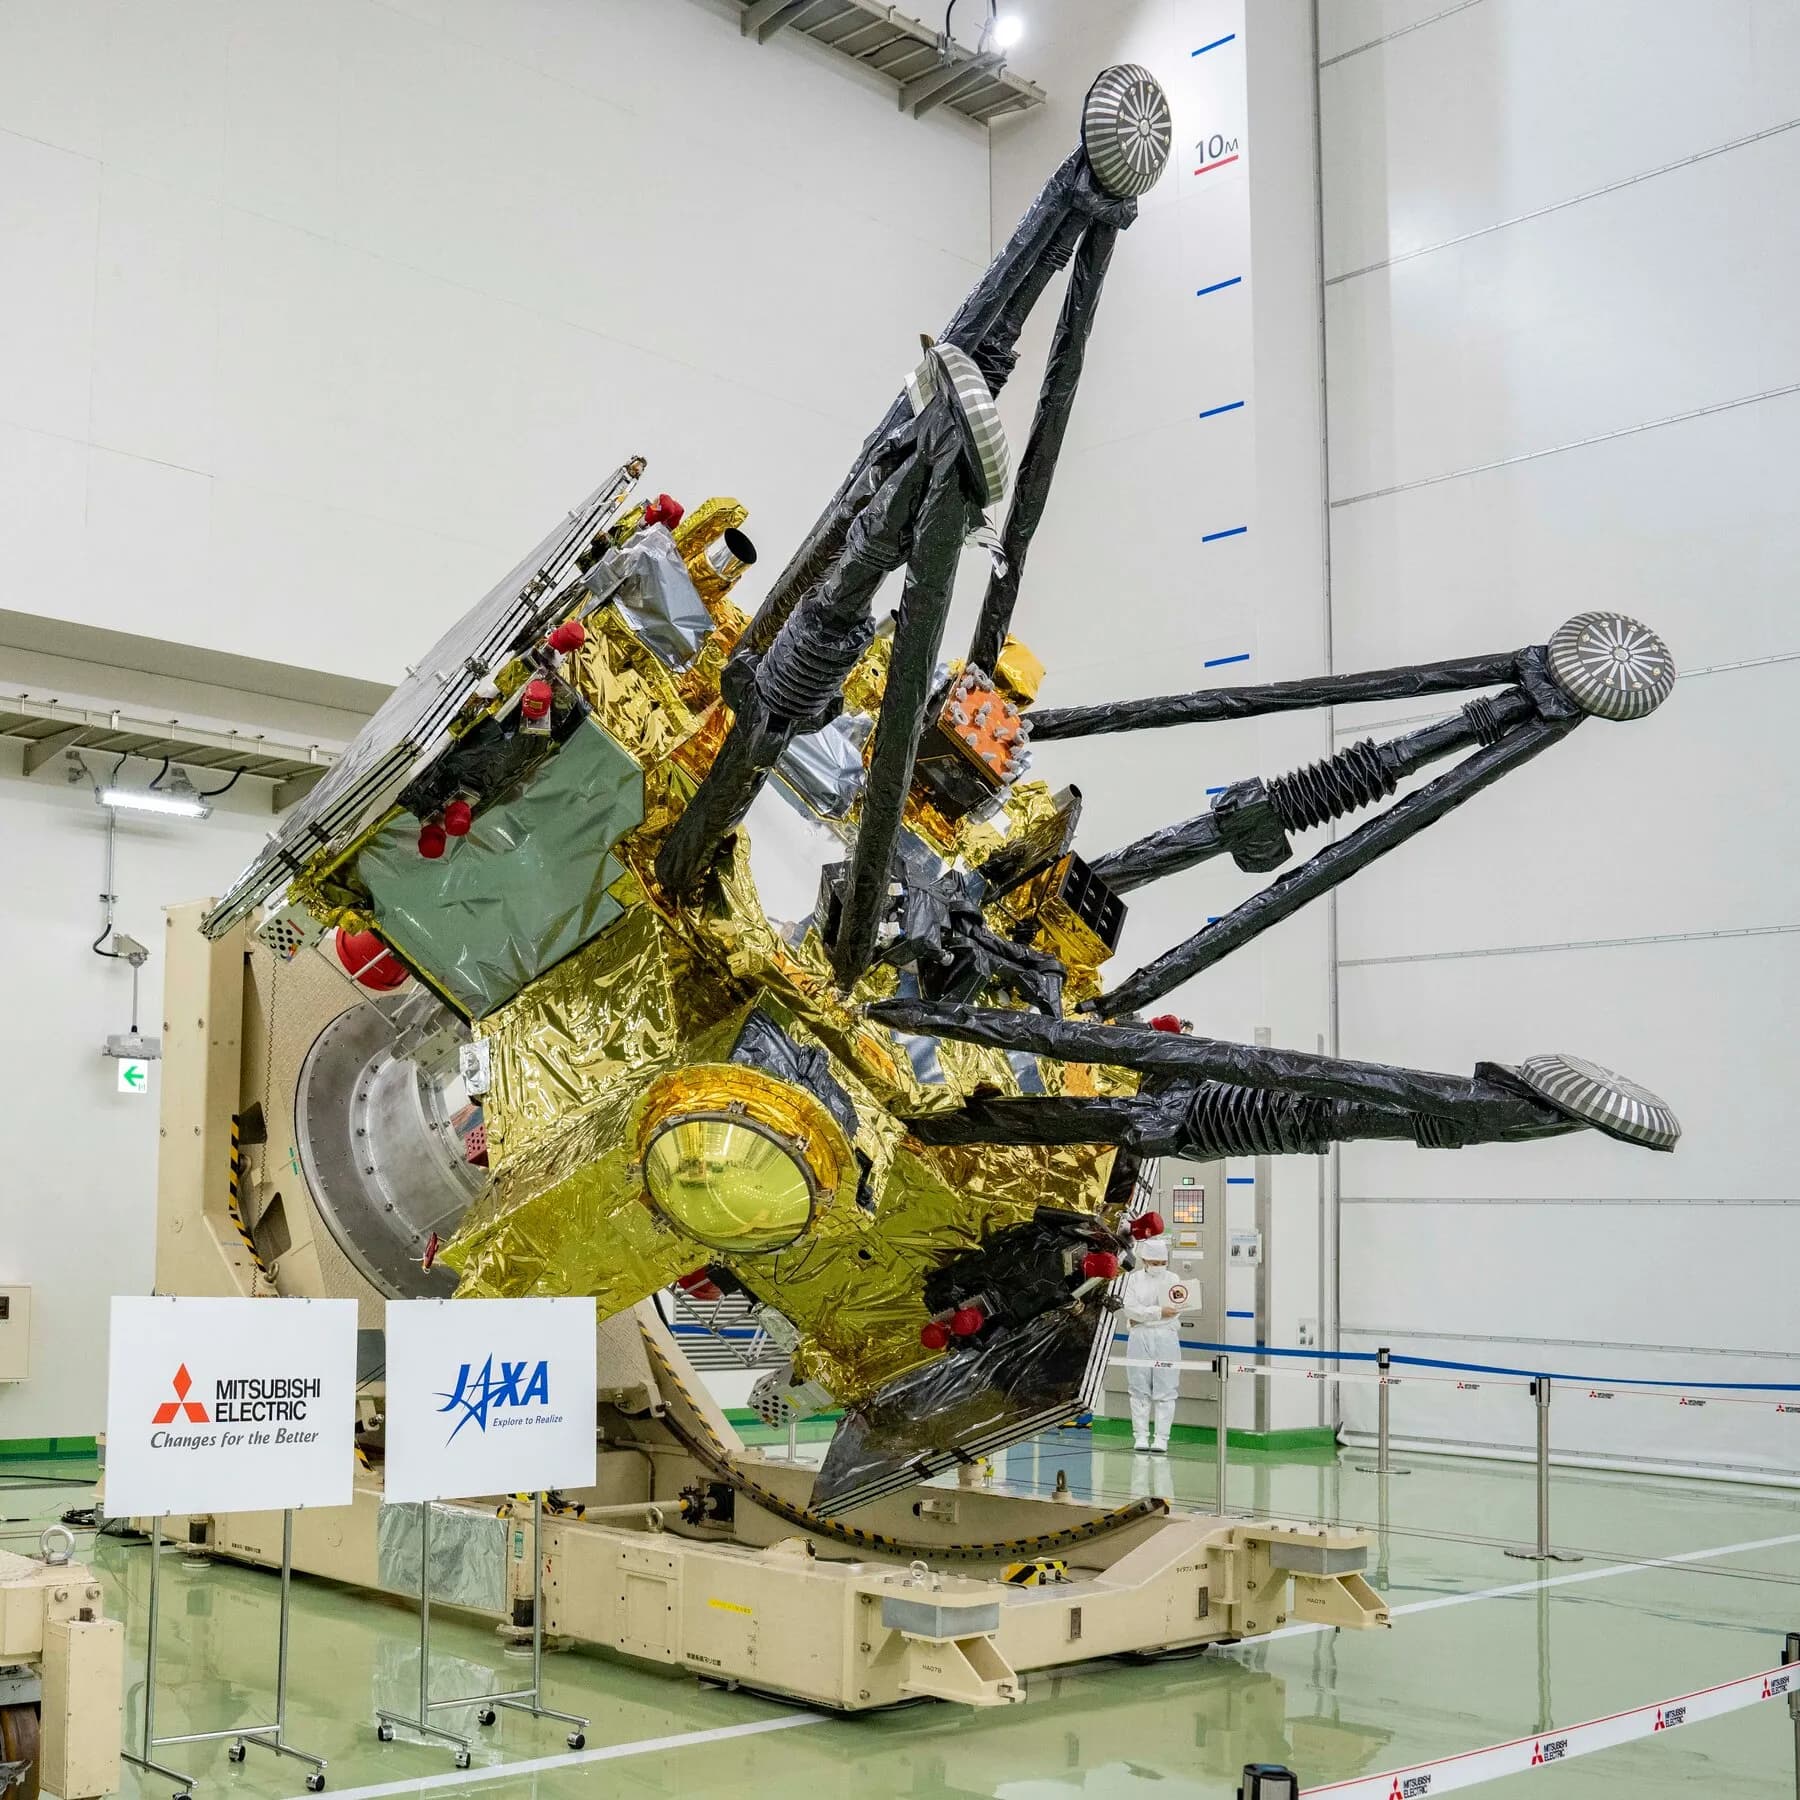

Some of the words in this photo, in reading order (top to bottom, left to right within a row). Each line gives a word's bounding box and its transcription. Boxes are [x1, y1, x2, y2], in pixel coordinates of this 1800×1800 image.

[216, 1378, 321, 1400] MITSUBISHI
[432, 1353, 549, 1434] JAXA
[215, 1401, 307, 1423] ELECTRIC
[492, 1417, 523, 1428] Explore
[525, 1416, 533, 1424] to
[535, 1414, 563, 1425] Realize
[150, 1431, 217, 1450] Changes
[220, 1431, 244, 1447] for
[248, 1430, 270, 1445] the
[275, 1427, 319, 1444] Better
